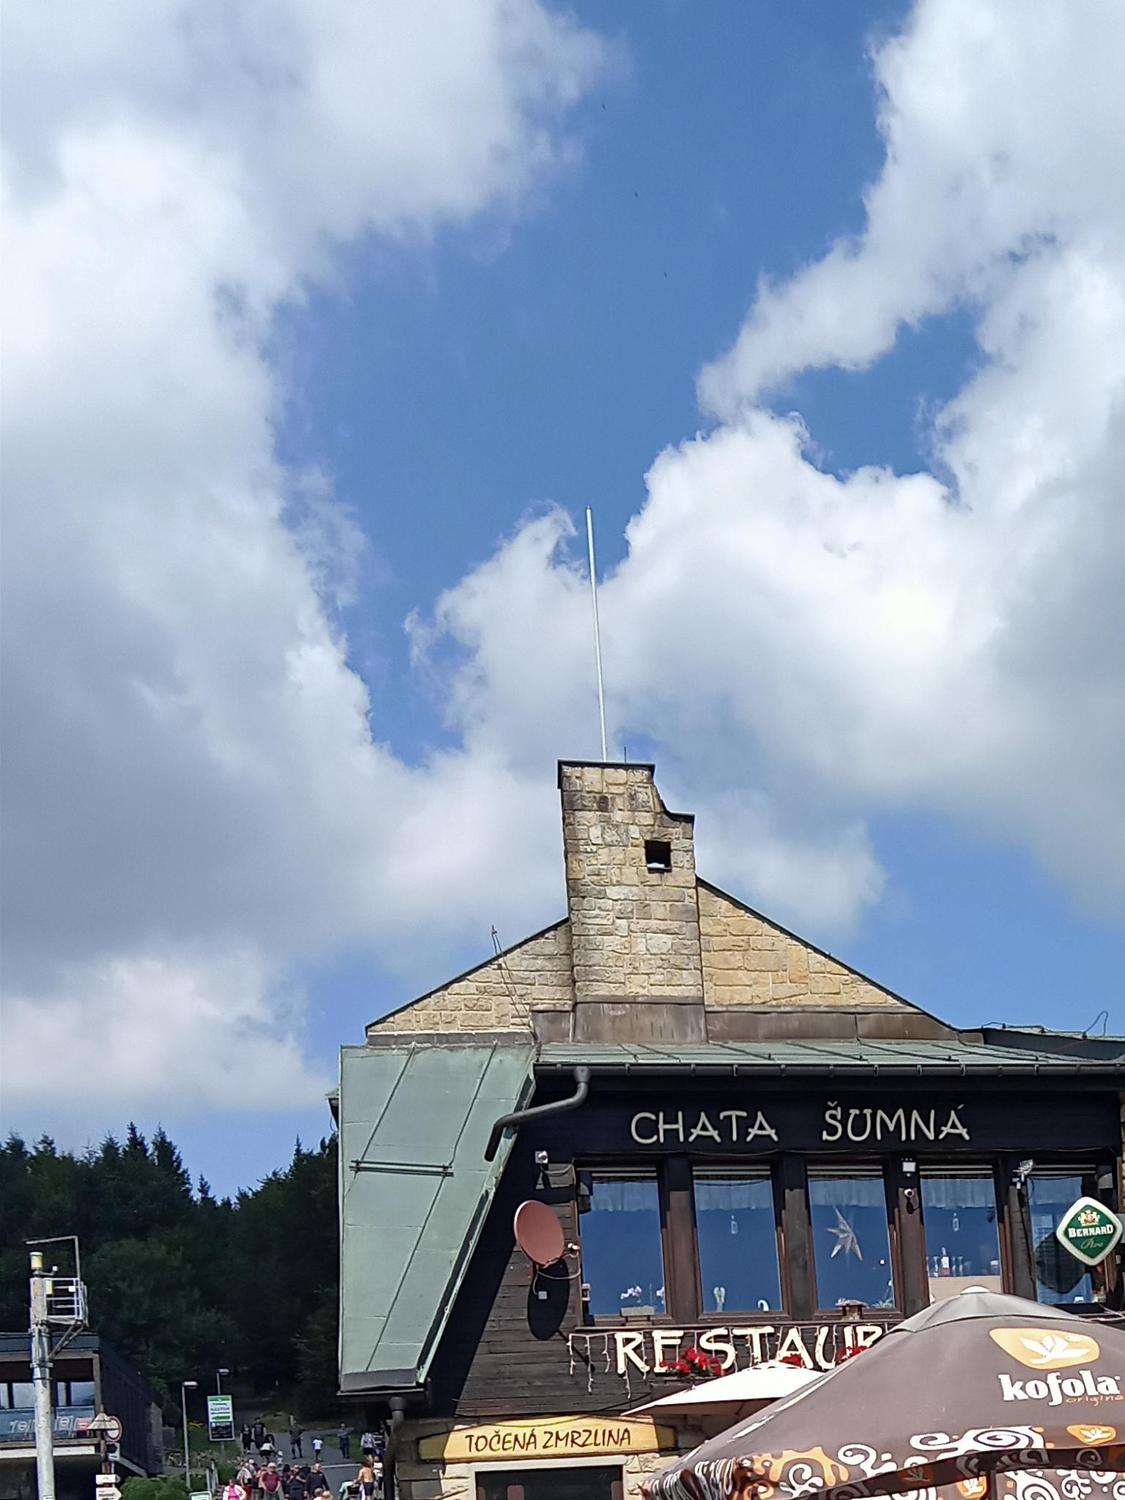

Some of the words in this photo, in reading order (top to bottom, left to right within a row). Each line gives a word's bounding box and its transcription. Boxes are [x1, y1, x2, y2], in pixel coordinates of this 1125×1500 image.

[631, 1110, 779, 1144] CHATA
[822, 1100, 971, 1142] ŠUMNÁ
[1068, 1224, 1114, 1239] BERNARD
[998, 1369, 1121, 1406] kofola
[465, 1428, 537, 1452] TOČENÁ
[542, 1427, 632, 1449] ZMRZLINA
